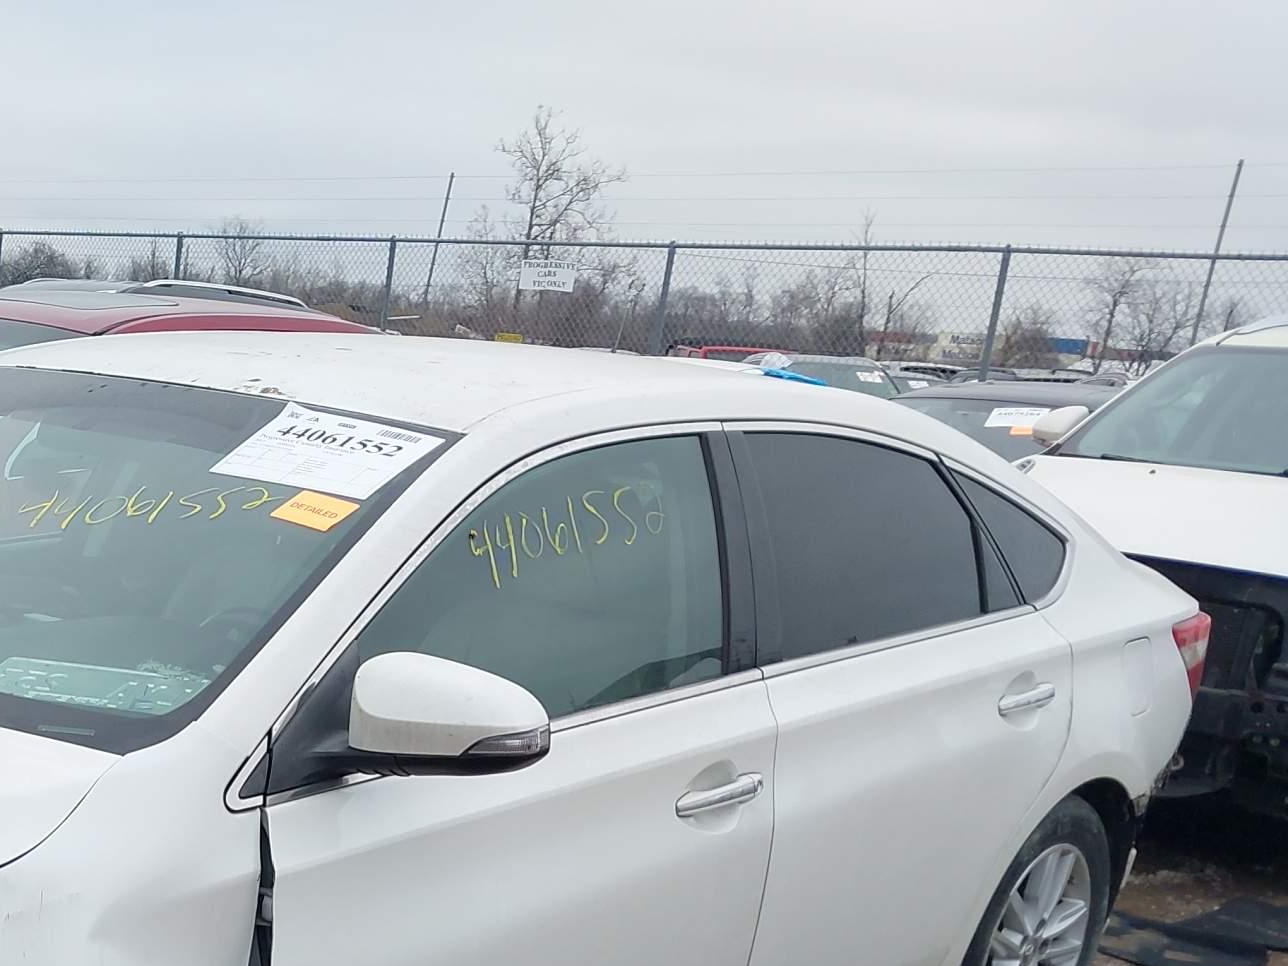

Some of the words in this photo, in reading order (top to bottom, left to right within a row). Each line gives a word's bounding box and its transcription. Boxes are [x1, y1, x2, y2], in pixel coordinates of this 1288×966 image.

[524, 261, 576, 270] PROGRESSIVE
[277, 424, 404, 458] 44061552
[19, 486, 285, 530] 44061552
[290, 501, 338, 519] DETAILED
[469, 482, 665, 588] 44061552
